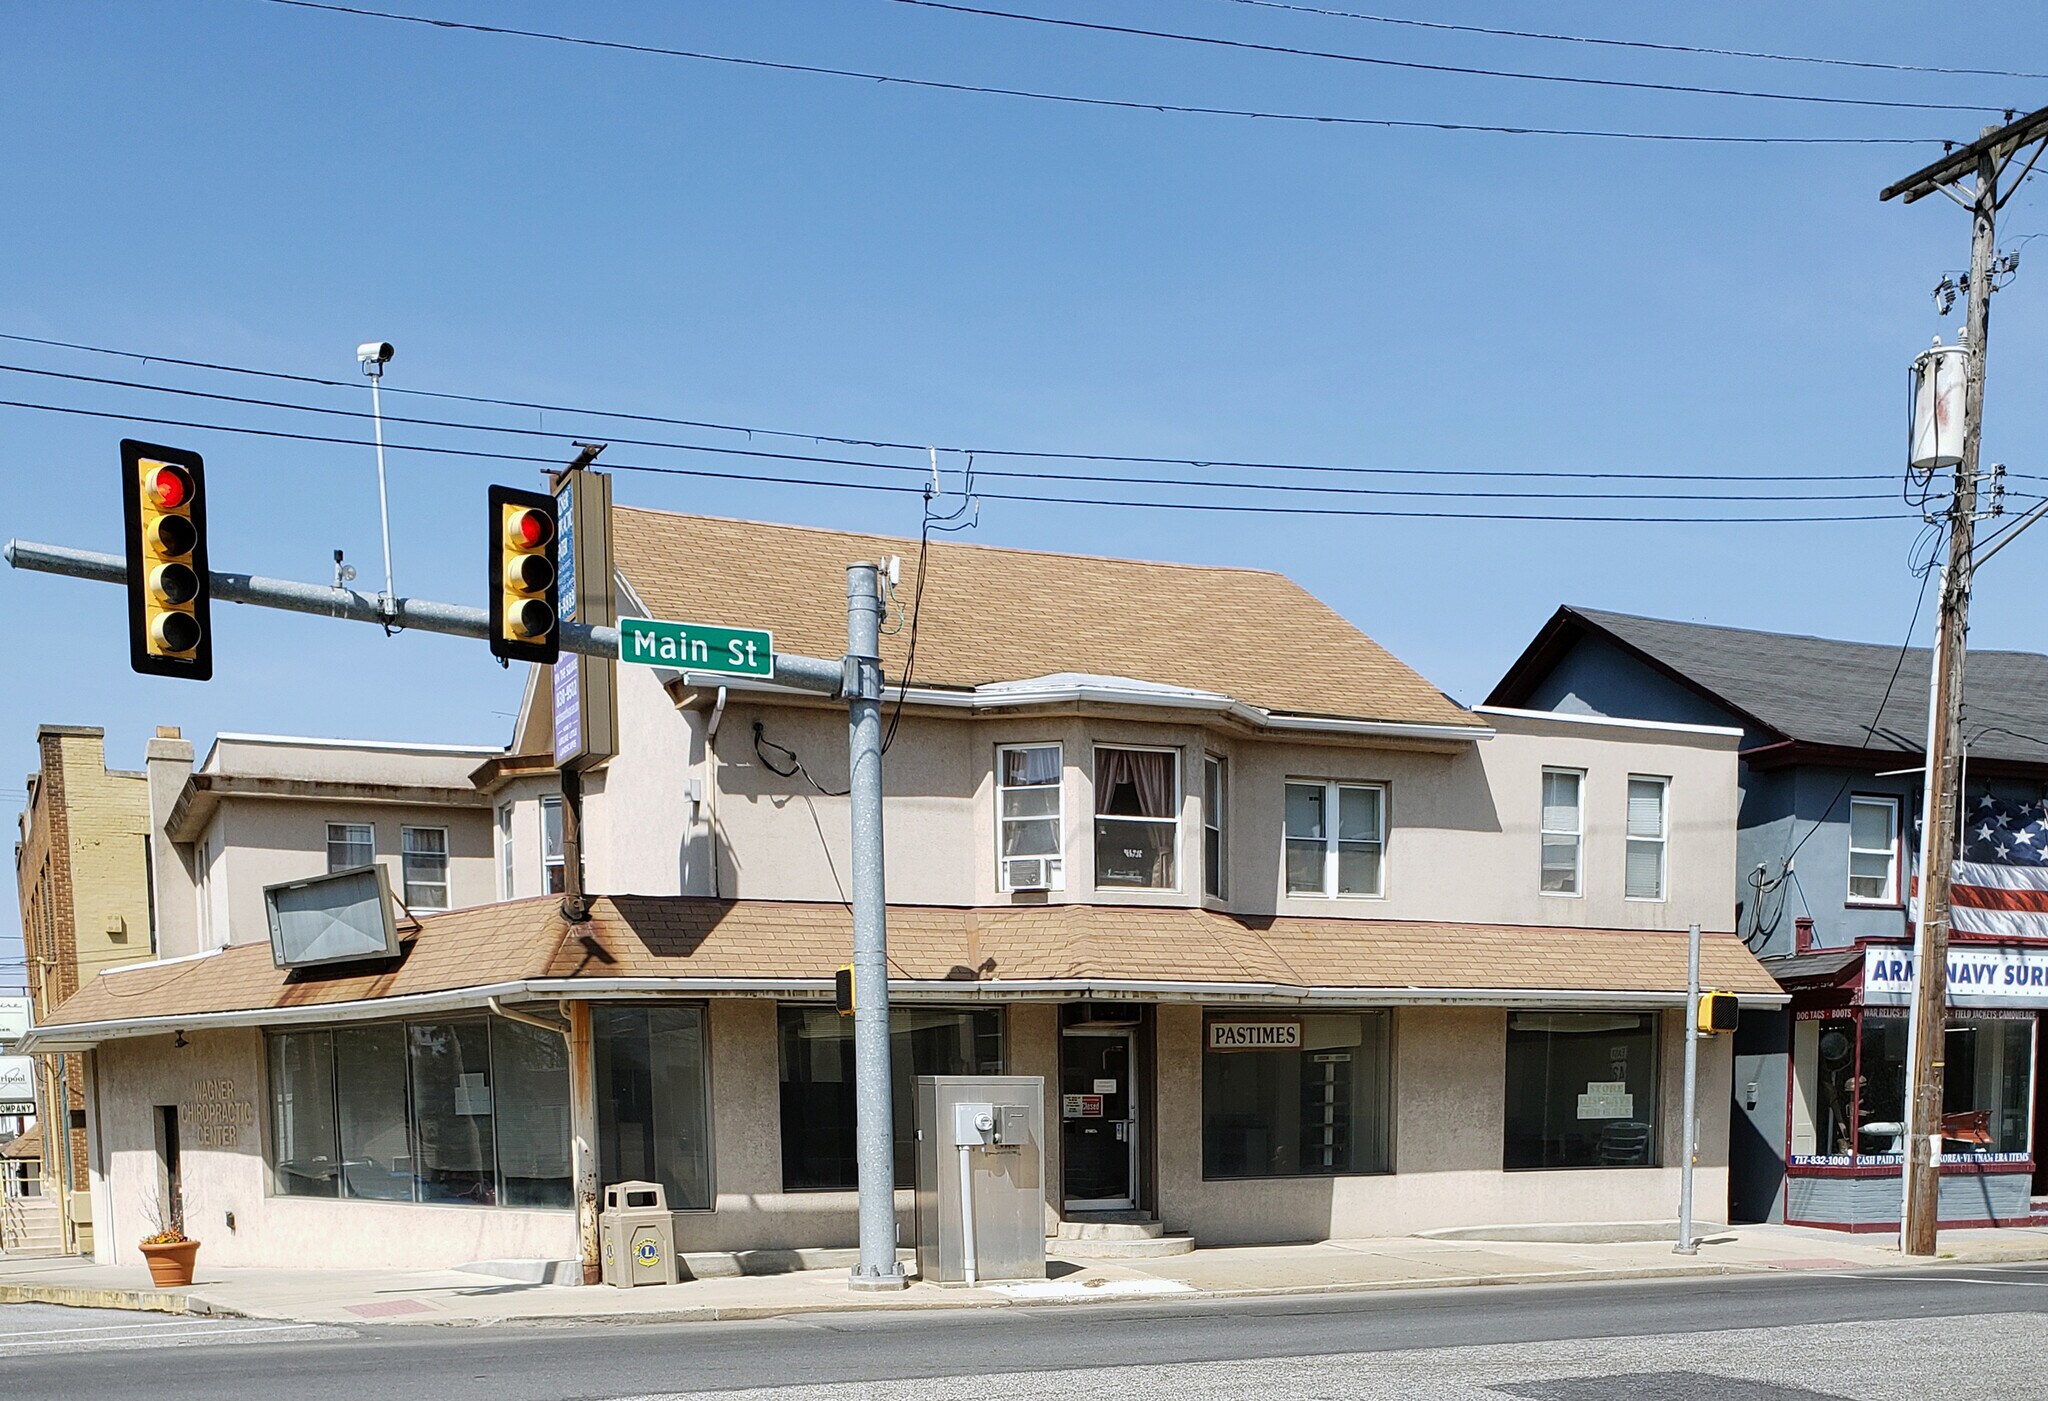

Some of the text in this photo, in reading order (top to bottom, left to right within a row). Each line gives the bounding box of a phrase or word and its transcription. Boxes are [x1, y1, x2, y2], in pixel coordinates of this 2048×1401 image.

[634, 629, 758, 667] Main St
[1946, 963, 1998, 985] NAVY
[2004, 965, 2048, 987] SUR
[1810, 1010, 1825, 1019] TAGS
[1831, 1008, 1852, 1018] BOOTS
[1863, 1008, 1878, 1018] WAR
[1955, 1010, 1972, 1019] FIELD
[1215, 1026, 1296, 1045] PASTIMES
[194, 1080, 236, 1100] WAGNER
[1589, 1084, 1624, 1093] STORE
[0, 1104, 31, 1113] OMPANY
[181, 1101, 252, 1123] CHIROPRACTIC
[198, 1125, 238, 1146] CENTER
[1795, 1155, 1850, 1166] 717-832-1000
[1856, 1155, 1904, 1165] CASH PAID FO
[1995, 1152, 2008, 1162] ERA
[2009, 1152, 2029, 1162] ITEMS
